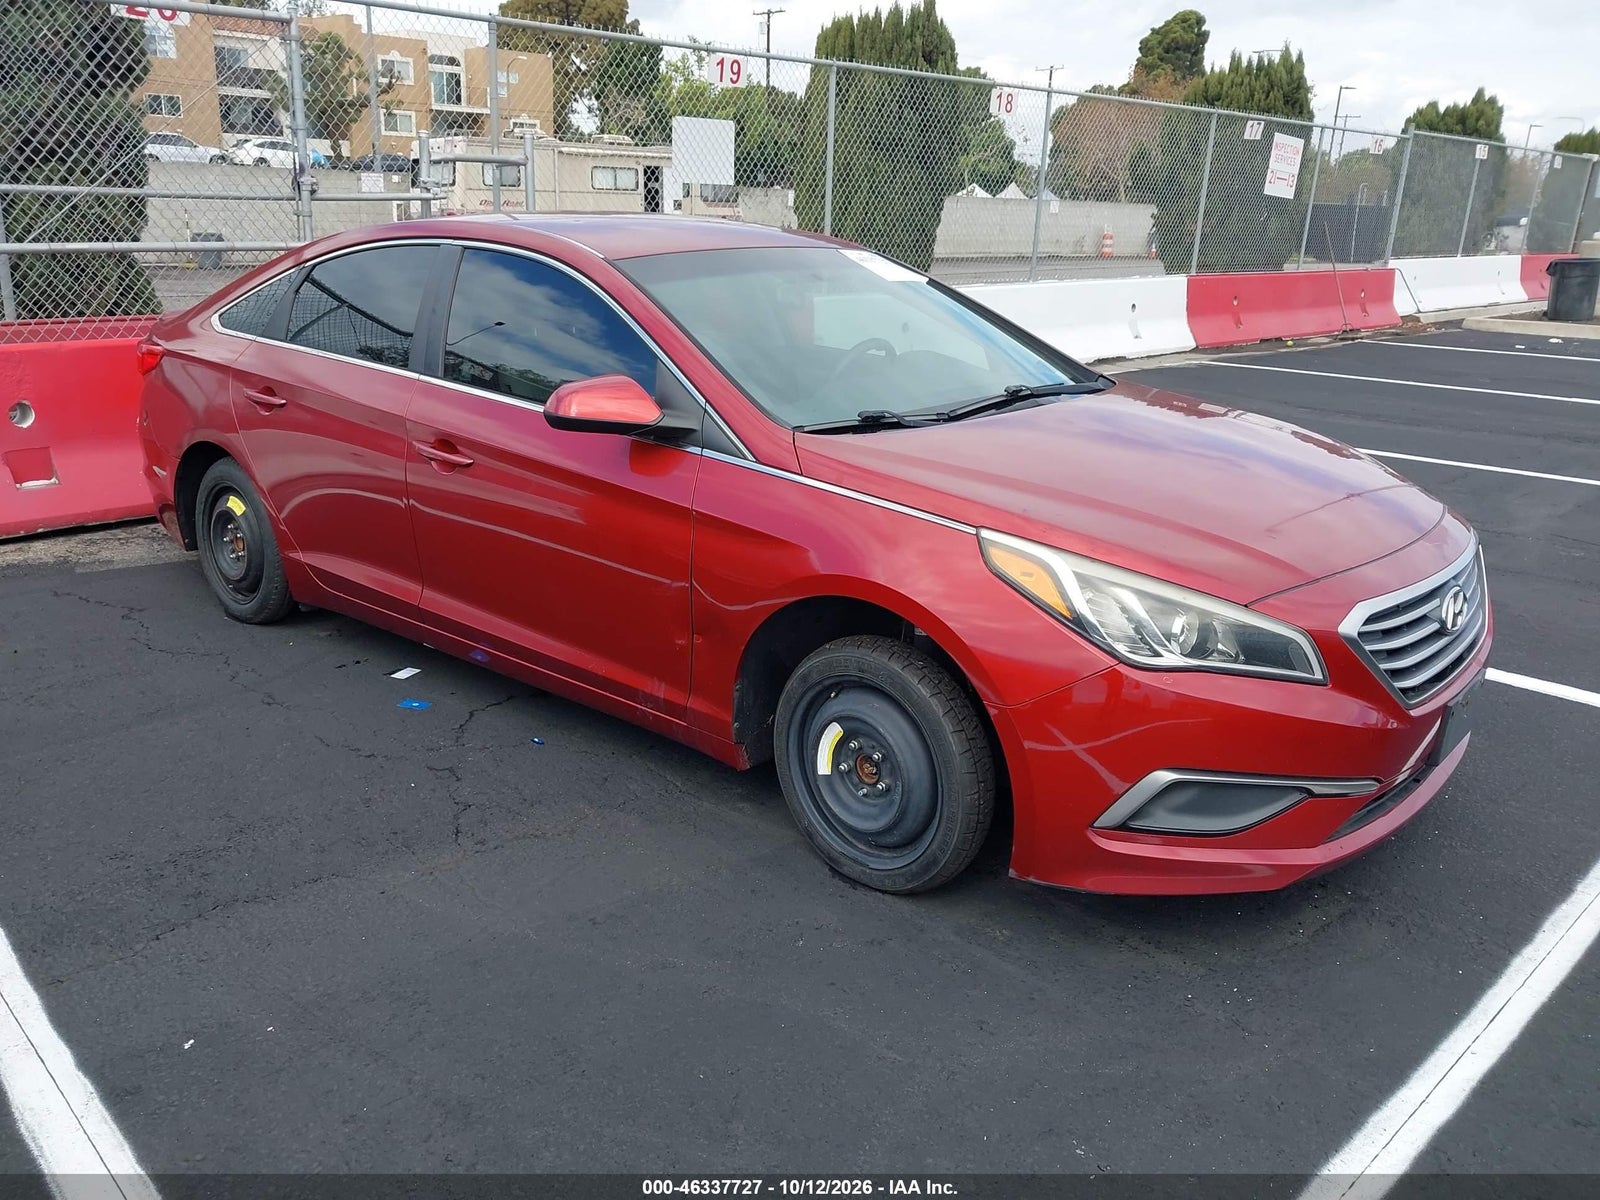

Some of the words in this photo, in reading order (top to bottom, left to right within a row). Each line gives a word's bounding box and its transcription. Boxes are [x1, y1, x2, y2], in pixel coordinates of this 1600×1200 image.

[715, 57, 742, 85] 19
[996, 91, 1014, 114] 18
[1249, 121, 1263, 139] 17
[1274, 141, 1300, 157] INSPECTION
[1373, 138, 1384, 153] 16
[1274, 153, 1297, 167] SERVICES
